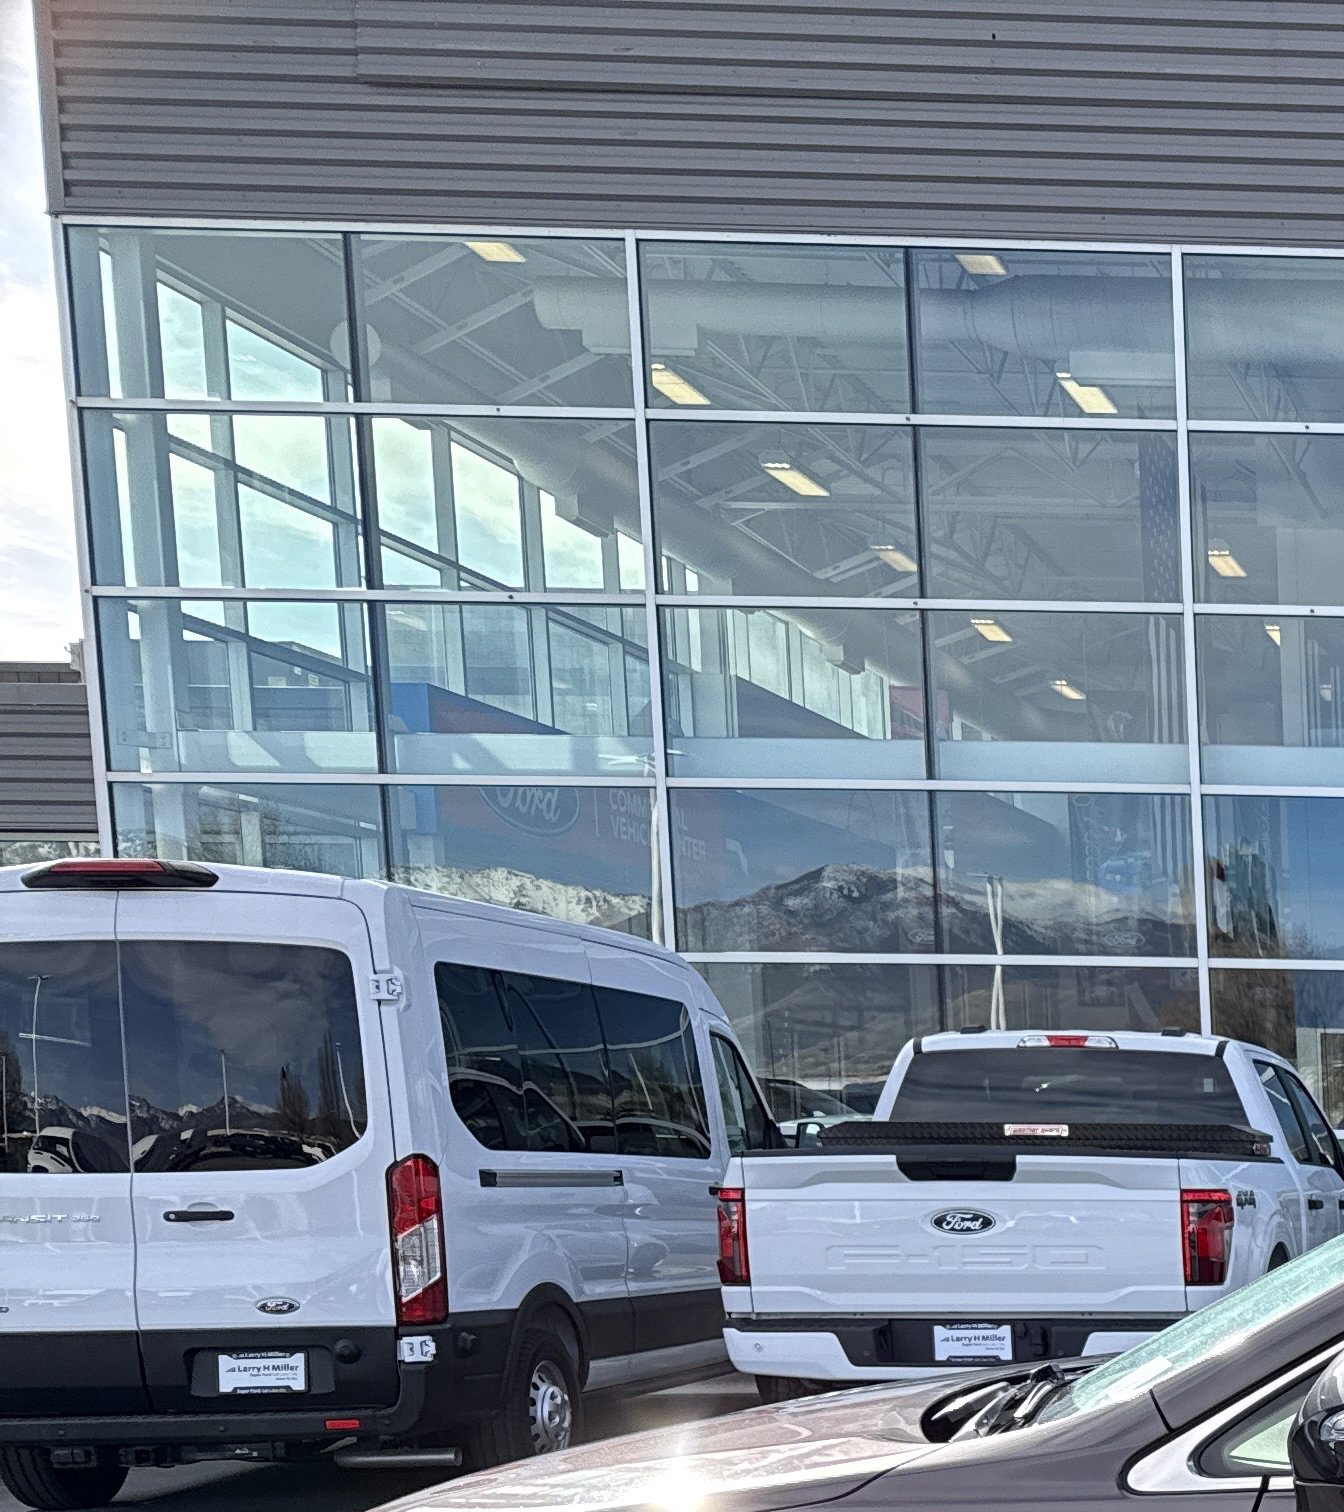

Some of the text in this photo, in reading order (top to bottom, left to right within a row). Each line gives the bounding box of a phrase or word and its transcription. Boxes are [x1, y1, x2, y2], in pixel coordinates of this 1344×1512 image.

[940, 1213, 983, 1232] Ford
[824, 1243, 1107, 1271] F-150
[951, 1333, 1006, 1343] Larry H Miller
[237, 1363, 300, 1373] Larry H Miller
